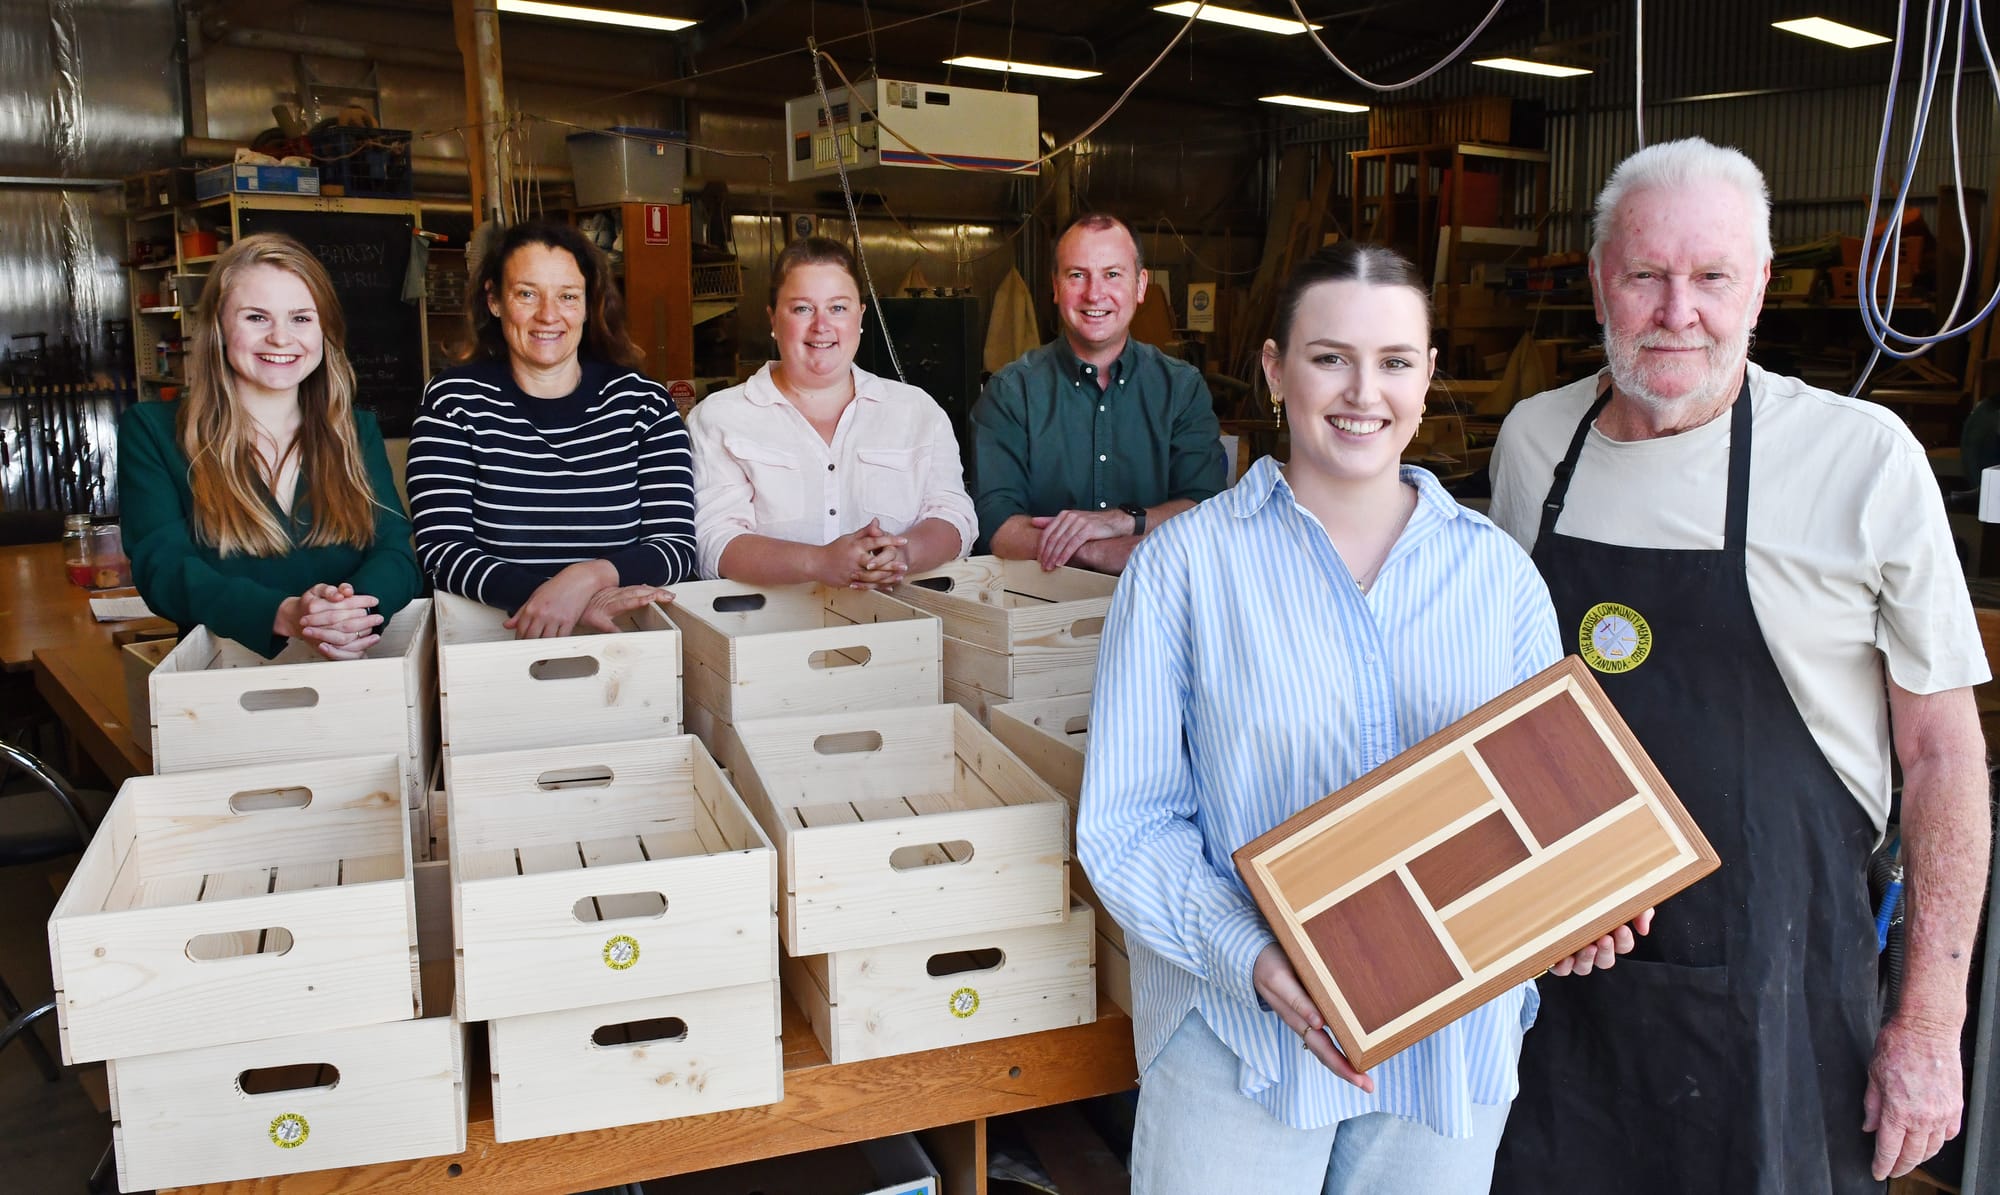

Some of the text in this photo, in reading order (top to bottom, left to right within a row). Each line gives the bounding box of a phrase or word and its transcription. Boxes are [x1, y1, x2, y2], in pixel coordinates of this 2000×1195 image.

[1581, 604, 1651, 663] THE BAROSSA COMMUNITY MEN'S SHED
[1591, 655, 1629, 671] TANUNDA
